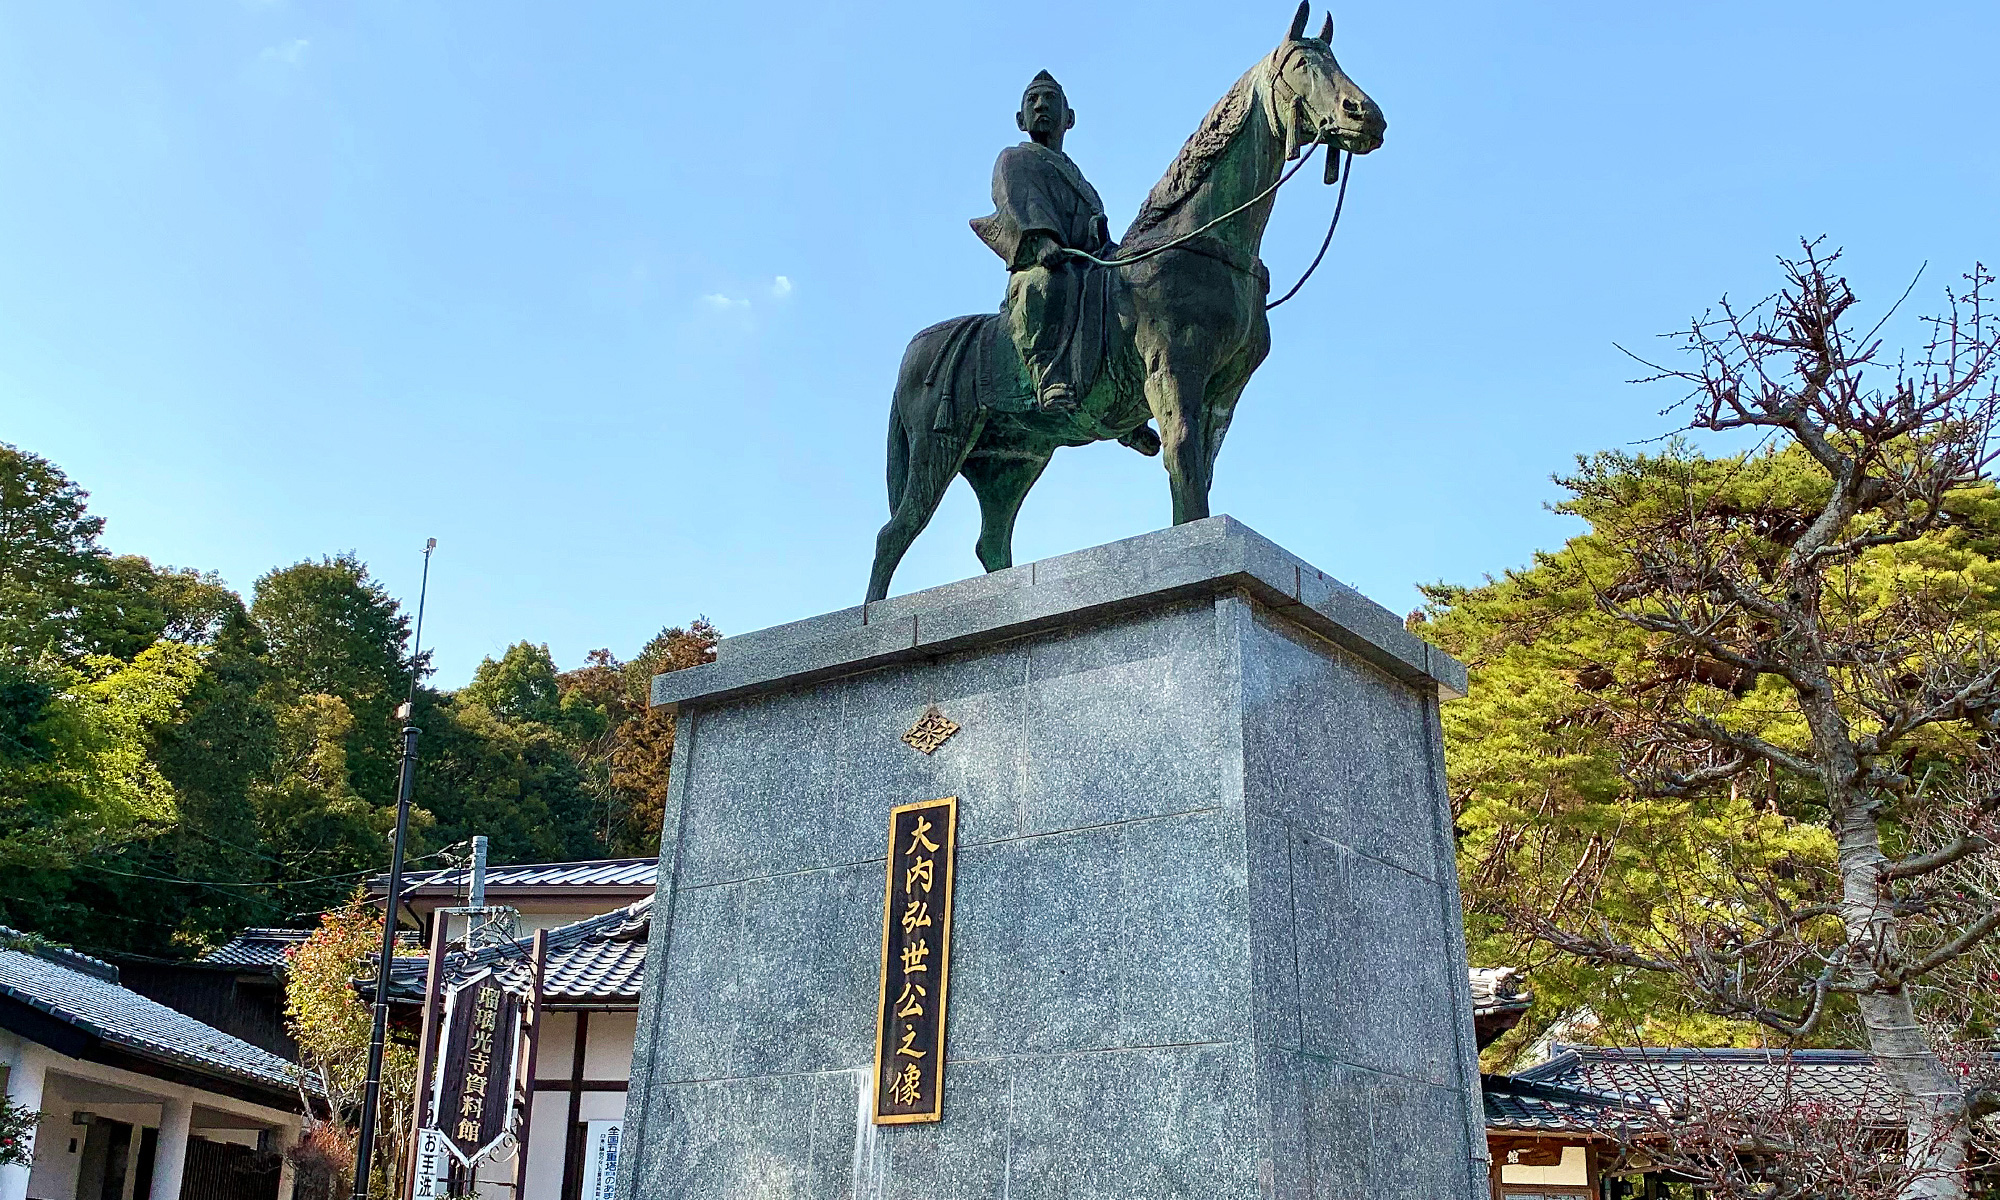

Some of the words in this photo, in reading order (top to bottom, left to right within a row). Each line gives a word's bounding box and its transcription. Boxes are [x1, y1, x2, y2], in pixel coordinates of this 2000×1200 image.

[458, 987, 500, 1143] 瑠璃光寺資料館
[889, 815, 940, 1105] 大内弘世公之像
